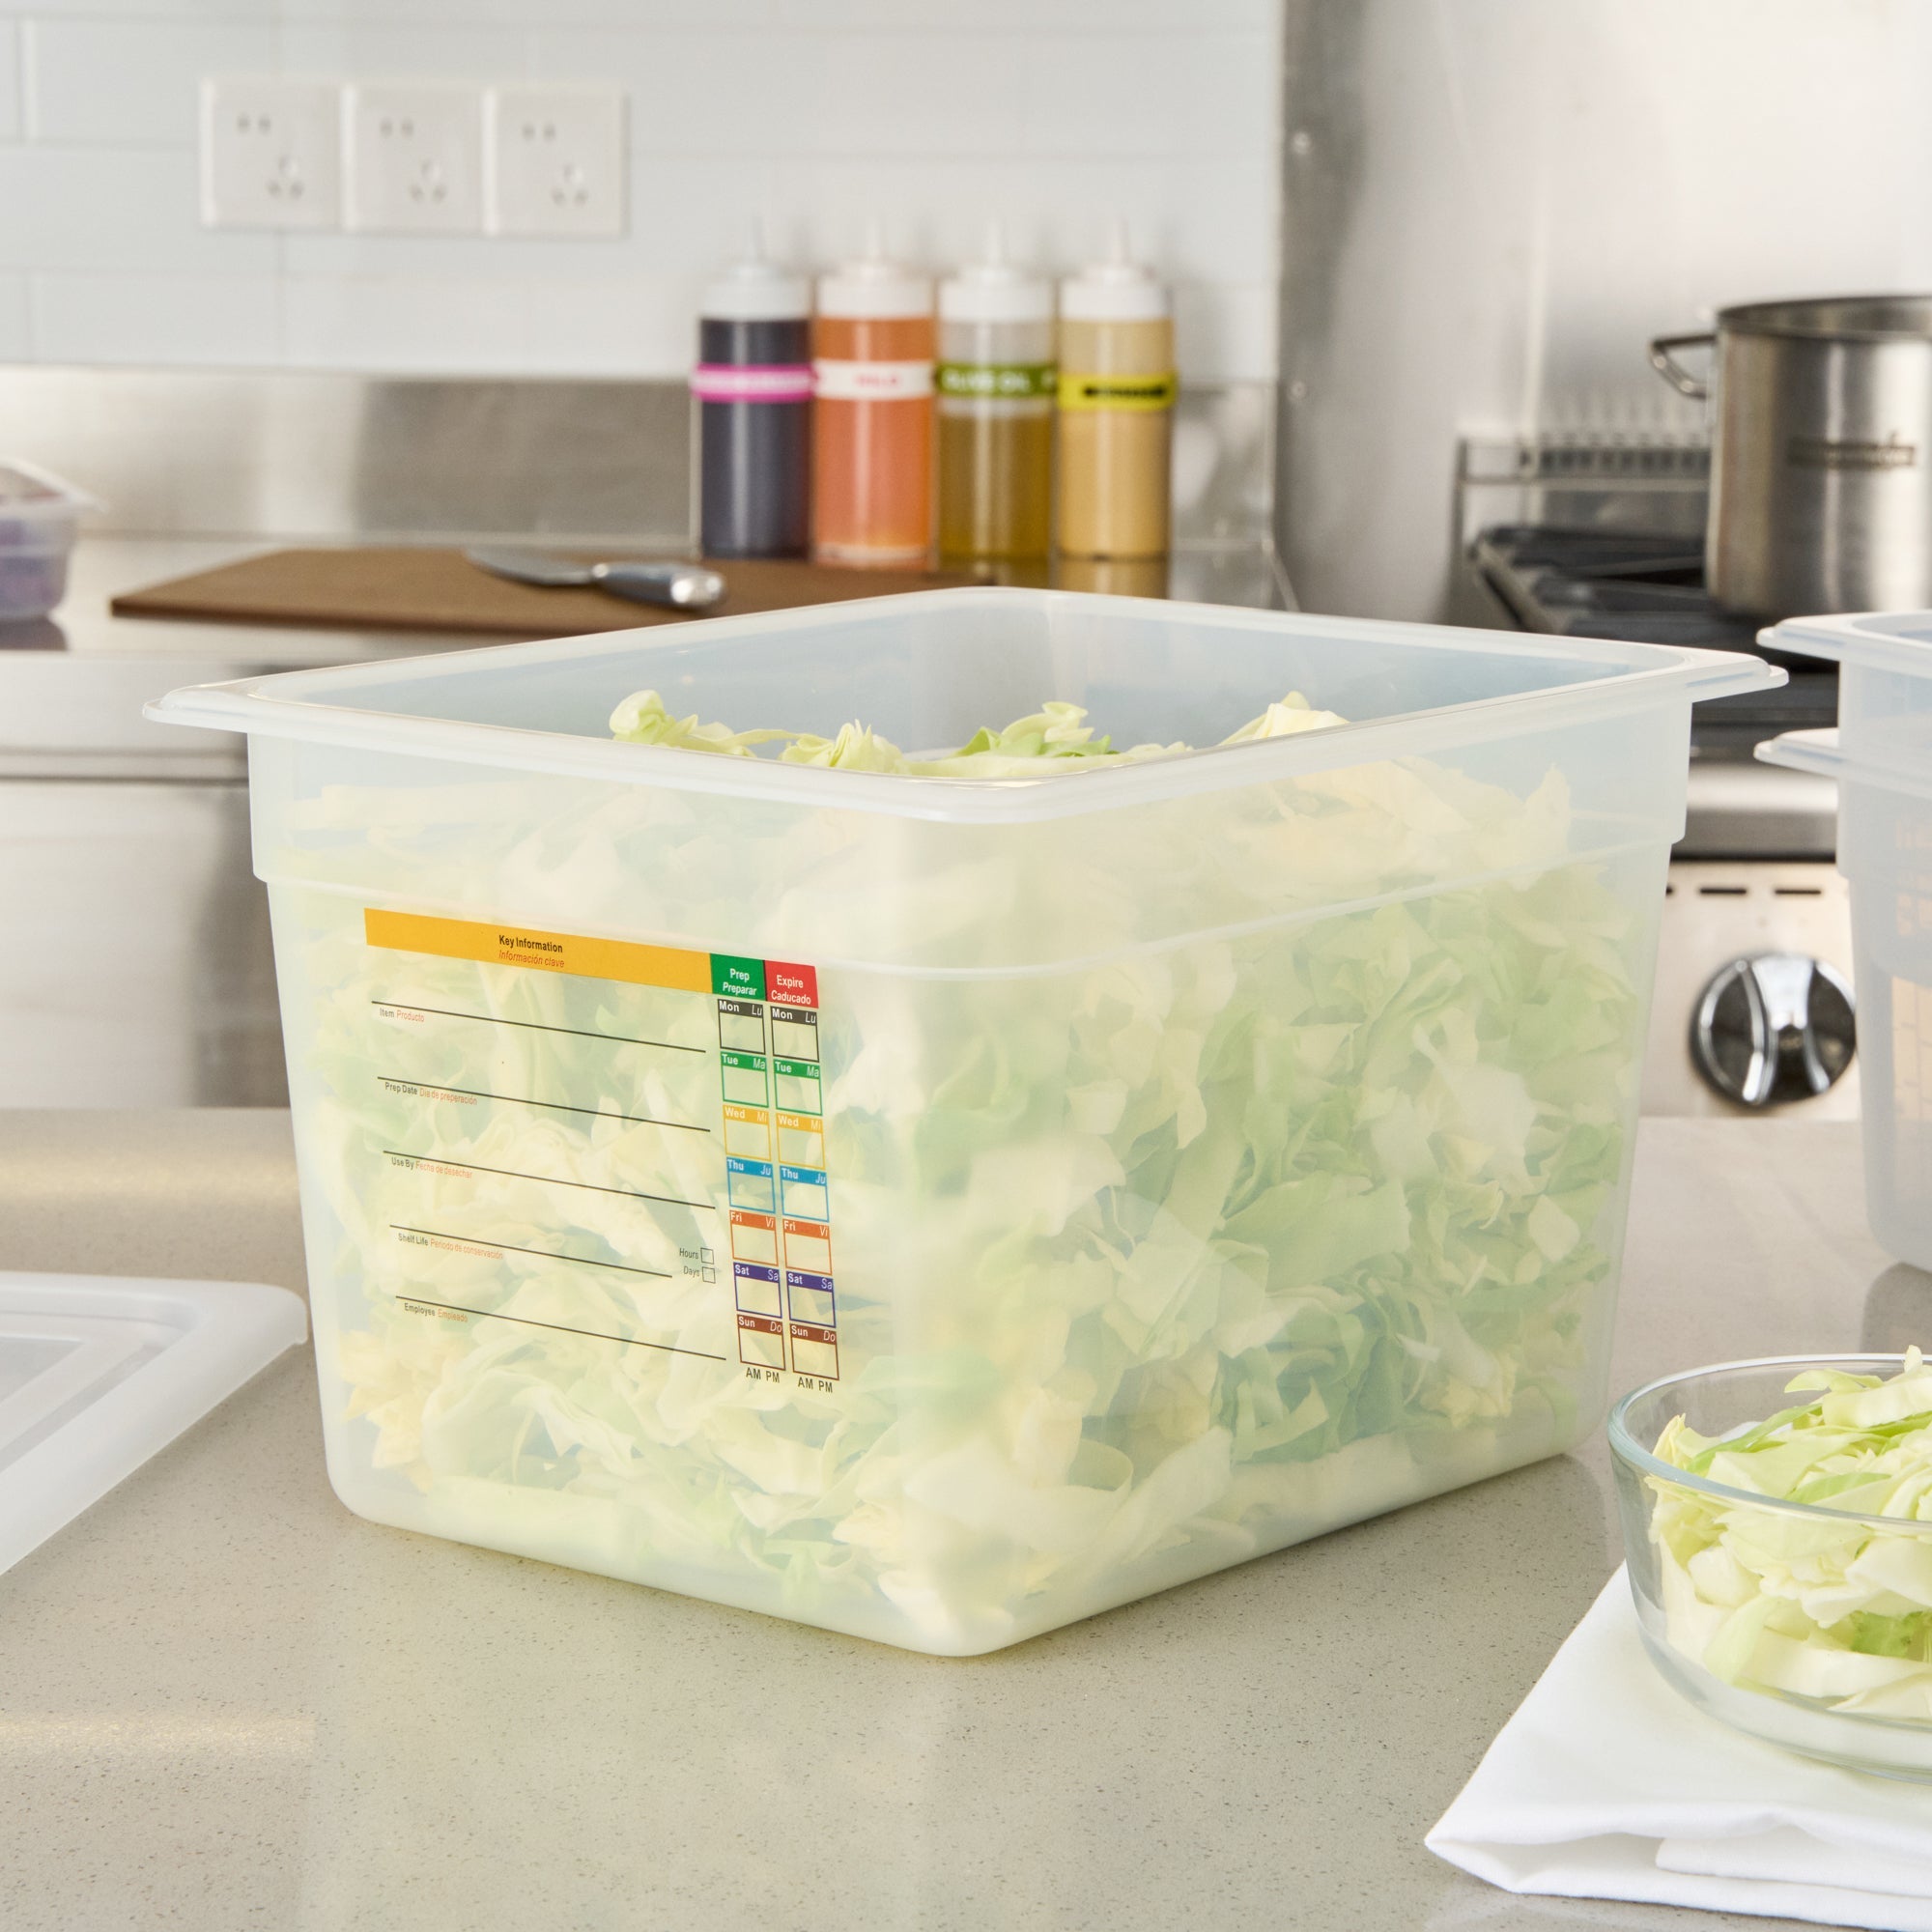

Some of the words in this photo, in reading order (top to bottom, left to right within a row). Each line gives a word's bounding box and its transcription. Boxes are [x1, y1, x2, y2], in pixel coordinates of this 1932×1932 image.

[498, 934, 515, 949] Key
[516, 937, 563, 952] Information
[498, 950, 544, 965] Información
[544, 957, 565, 968] clave
[729, 968, 751, 983] Prep
[776, 974, 804, 989] Expire
[722, 981, 757, 996] Preparar
[771, 989, 811, 1005] Caducado
[379, 1008, 395, 1018] Item
[396, 1009, 425, 1022] Producto
[719, 1000, 740, 1012] Mon
[752, 1004, 762, 1016] Lu
[772, 1008, 793, 1020] Mon
[805, 1011, 816, 1024] Lu
[722, 1053, 739, 1065] Tue
[753, 1058, 766, 1069] Ma
[775, 1061, 792, 1073] Tue
[807, 1065, 819, 1077] Ma
[384, 1081, 401, 1094] Prep
[402, 1085, 418, 1095] Date
[431, 1091, 440, 1099] de
[724, 1106, 746, 1119] Wed
[756, 1111, 767, 1122] Mi
[778, 1114, 799, 1127] Wed
[810, 1119, 821, 1131] Mi
[391, 1156, 404, 1167] Use
[405, 1159, 414, 1170] By
[415, 1160, 435, 1173] Fecha
[435, 1165, 443, 1174] de
[726, 1158, 745, 1171] Thu
[760, 1164, 772, 1176] Ju
[781, 1167, 799, 1179] Thu
[815, 1173, 826, 1184] Ju
[730, 1211, 742, 1223] Fri
[765, 1216, 774, 1229] Vi
[783, 1220, 796, 1232] Fri
[819, 1225, 828, 1236] Vi
[398, 1233, 415, 1244] Shelf
[415, 1236, 428, 1246] Life
[454, 1243, 463, 1252] de
[679, 1247, 699, 1260] Hours
[683, 1265, 700, 1278] Days
[735, 1264, 750, 1276] Sat
[767, 1269, 779, 1281] Sa
[788, 1272, 803, 1285] Sat
[821, 1278, 833, 1290] Sa
[404, 1302, 436, 1317] Employee
[438, 1308, 469, 1322] Empleado
[738, 1316, 755, 1328] Sun
[770, 1321, 782, 1333] Do
[791, 1325, 809, 1337] Sun
[823, 1330, 836, 1342] Do
[746, 1367, 761, 1380] AM
[765, 1370, 780, 1383] PM
[797, 1377, 813, 1389] AM
[818, 1379, 833, 1393] PM
